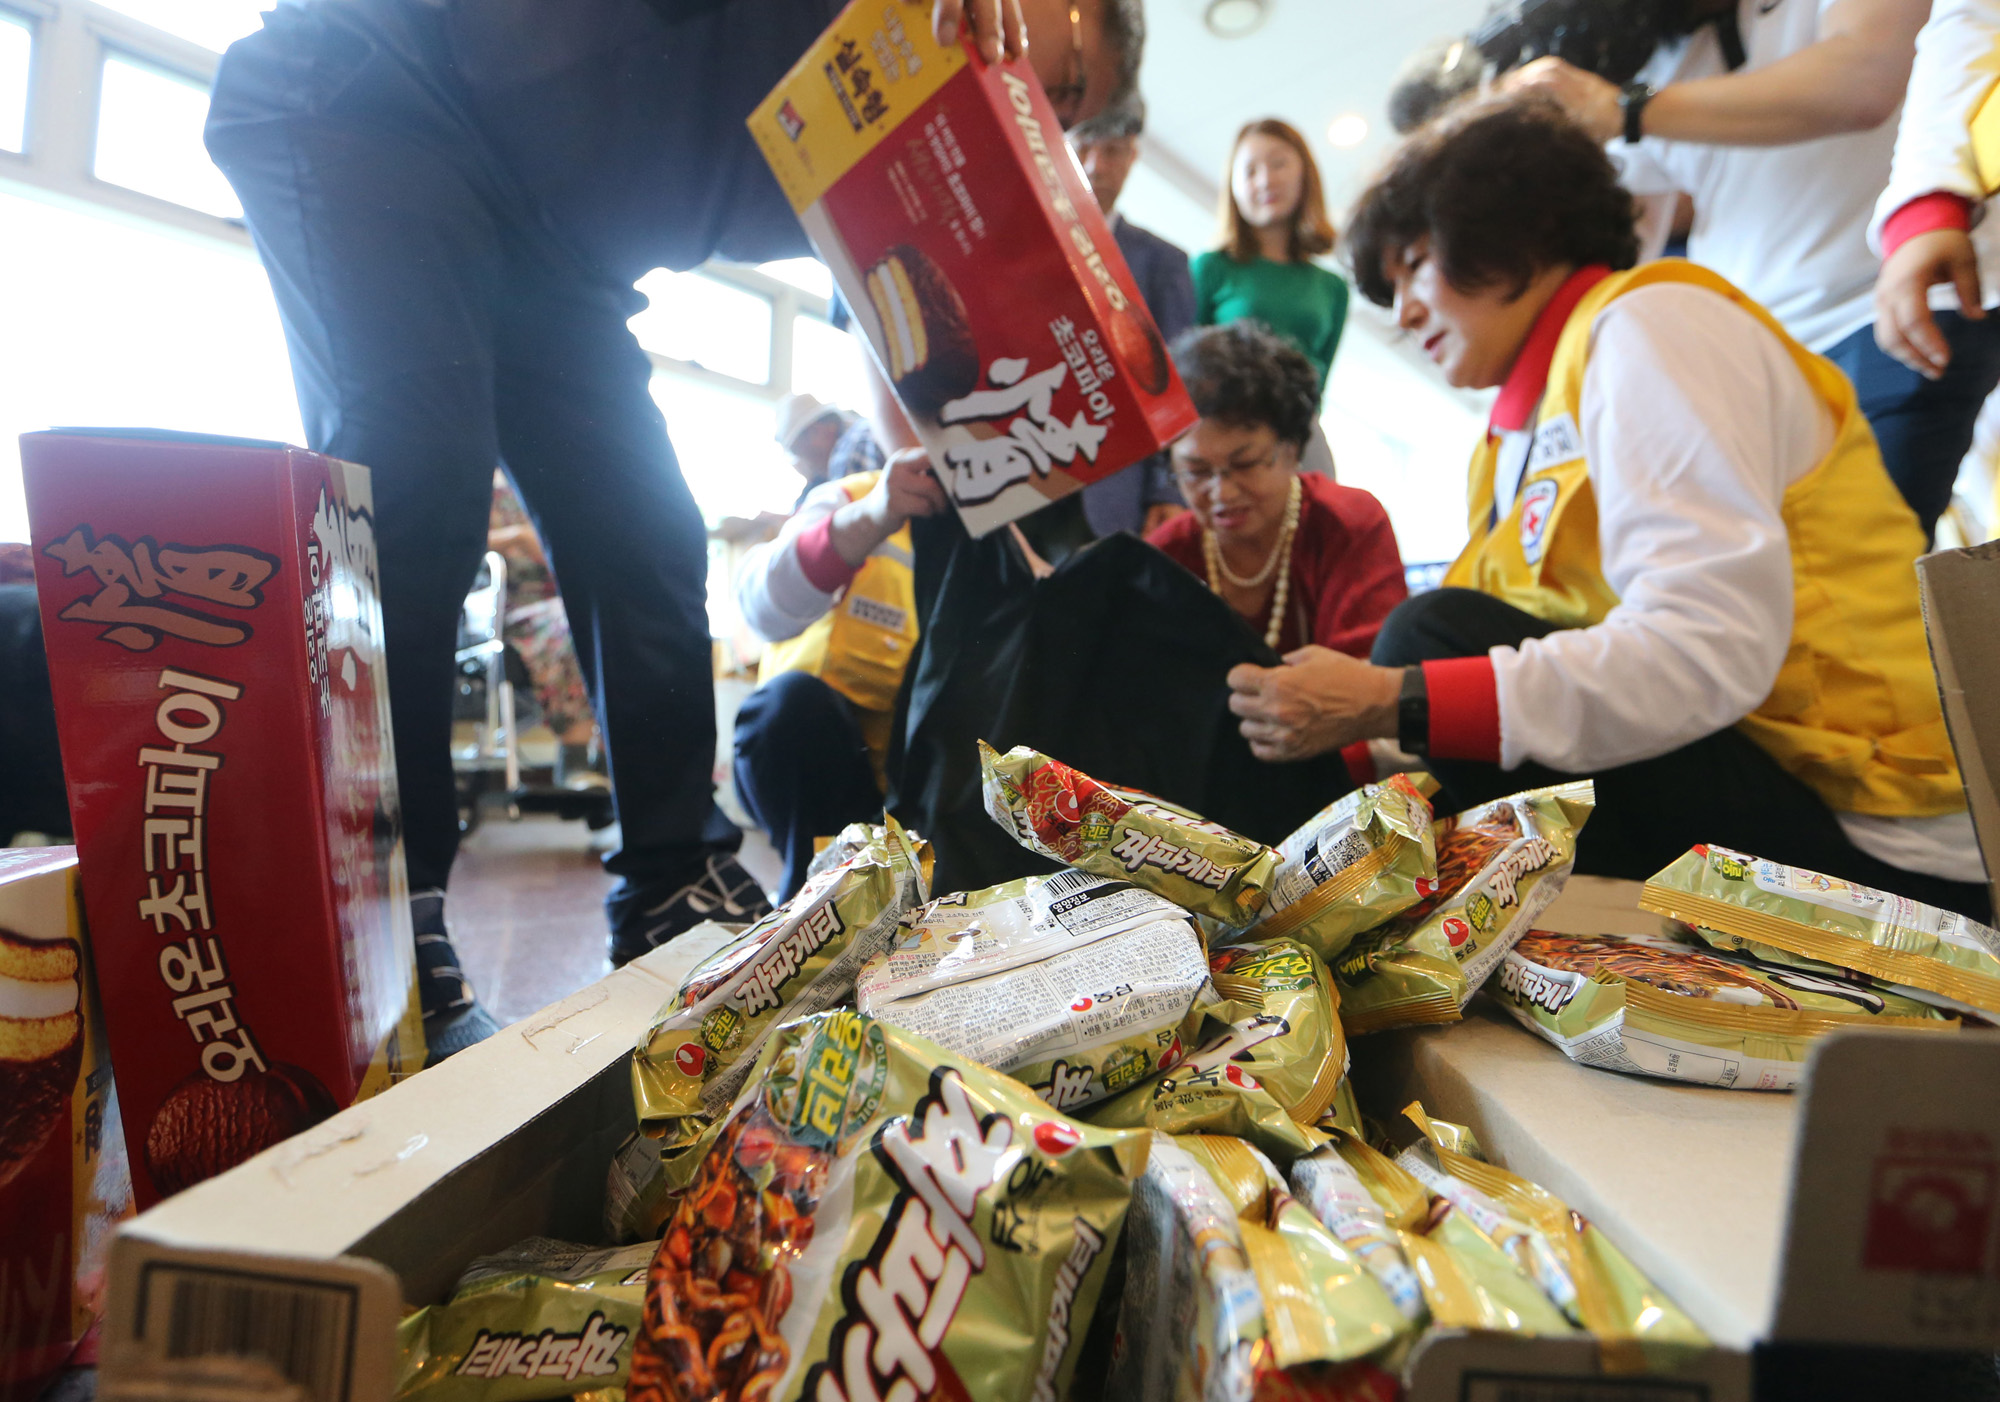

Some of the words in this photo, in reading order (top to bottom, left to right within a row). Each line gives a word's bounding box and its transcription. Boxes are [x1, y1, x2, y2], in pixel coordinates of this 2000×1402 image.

[832, 33, 891, 129] 실속형
[1002, 70, 1077, 226] 초코파이
[1069, 222, 1131, 312] 오리온
[1049, 315, 1116, 423] 초코파이
[1080, 328, 1116, 382] 오리온
[138, 666, 245, 933] 초코파이
[1078, 820, 1113, 844] 올리브
[1110, 828, 1239, 893] 짜파게티
[1489, 832, 1565, 910] 짜파게티
[1052, 892, 1091, 913] 영양정보
[1471, 898, 1491, 932] 올리브
[734, 901, 846, 1017] 짜파게티
[1499, 958, 1570, 1017] 짜파게
[158, 934, 273, 1085] 오리온
[1086, 1023, 1101, 1036] 반품
[1103, 1021, 1111, 1031] 및
[1157, 1003, 1165, 1013] 각
[1166, 996, 1183, 1010] 공장,
[1093, 981, 1133, 1004] 농심
[708, 1008, 738, 1053] 올리브
[810, 1012, 866, 1138] 올리브
[870, 1038, 888, 1092] OLIVE
[1107, 1056, 1151, 1088] 올리브
[856, 1092, 879, 1121] OIL
[991, 1156, 1055, 1254] 농심
[456, 1313, 629, 1382] 짜파게티
